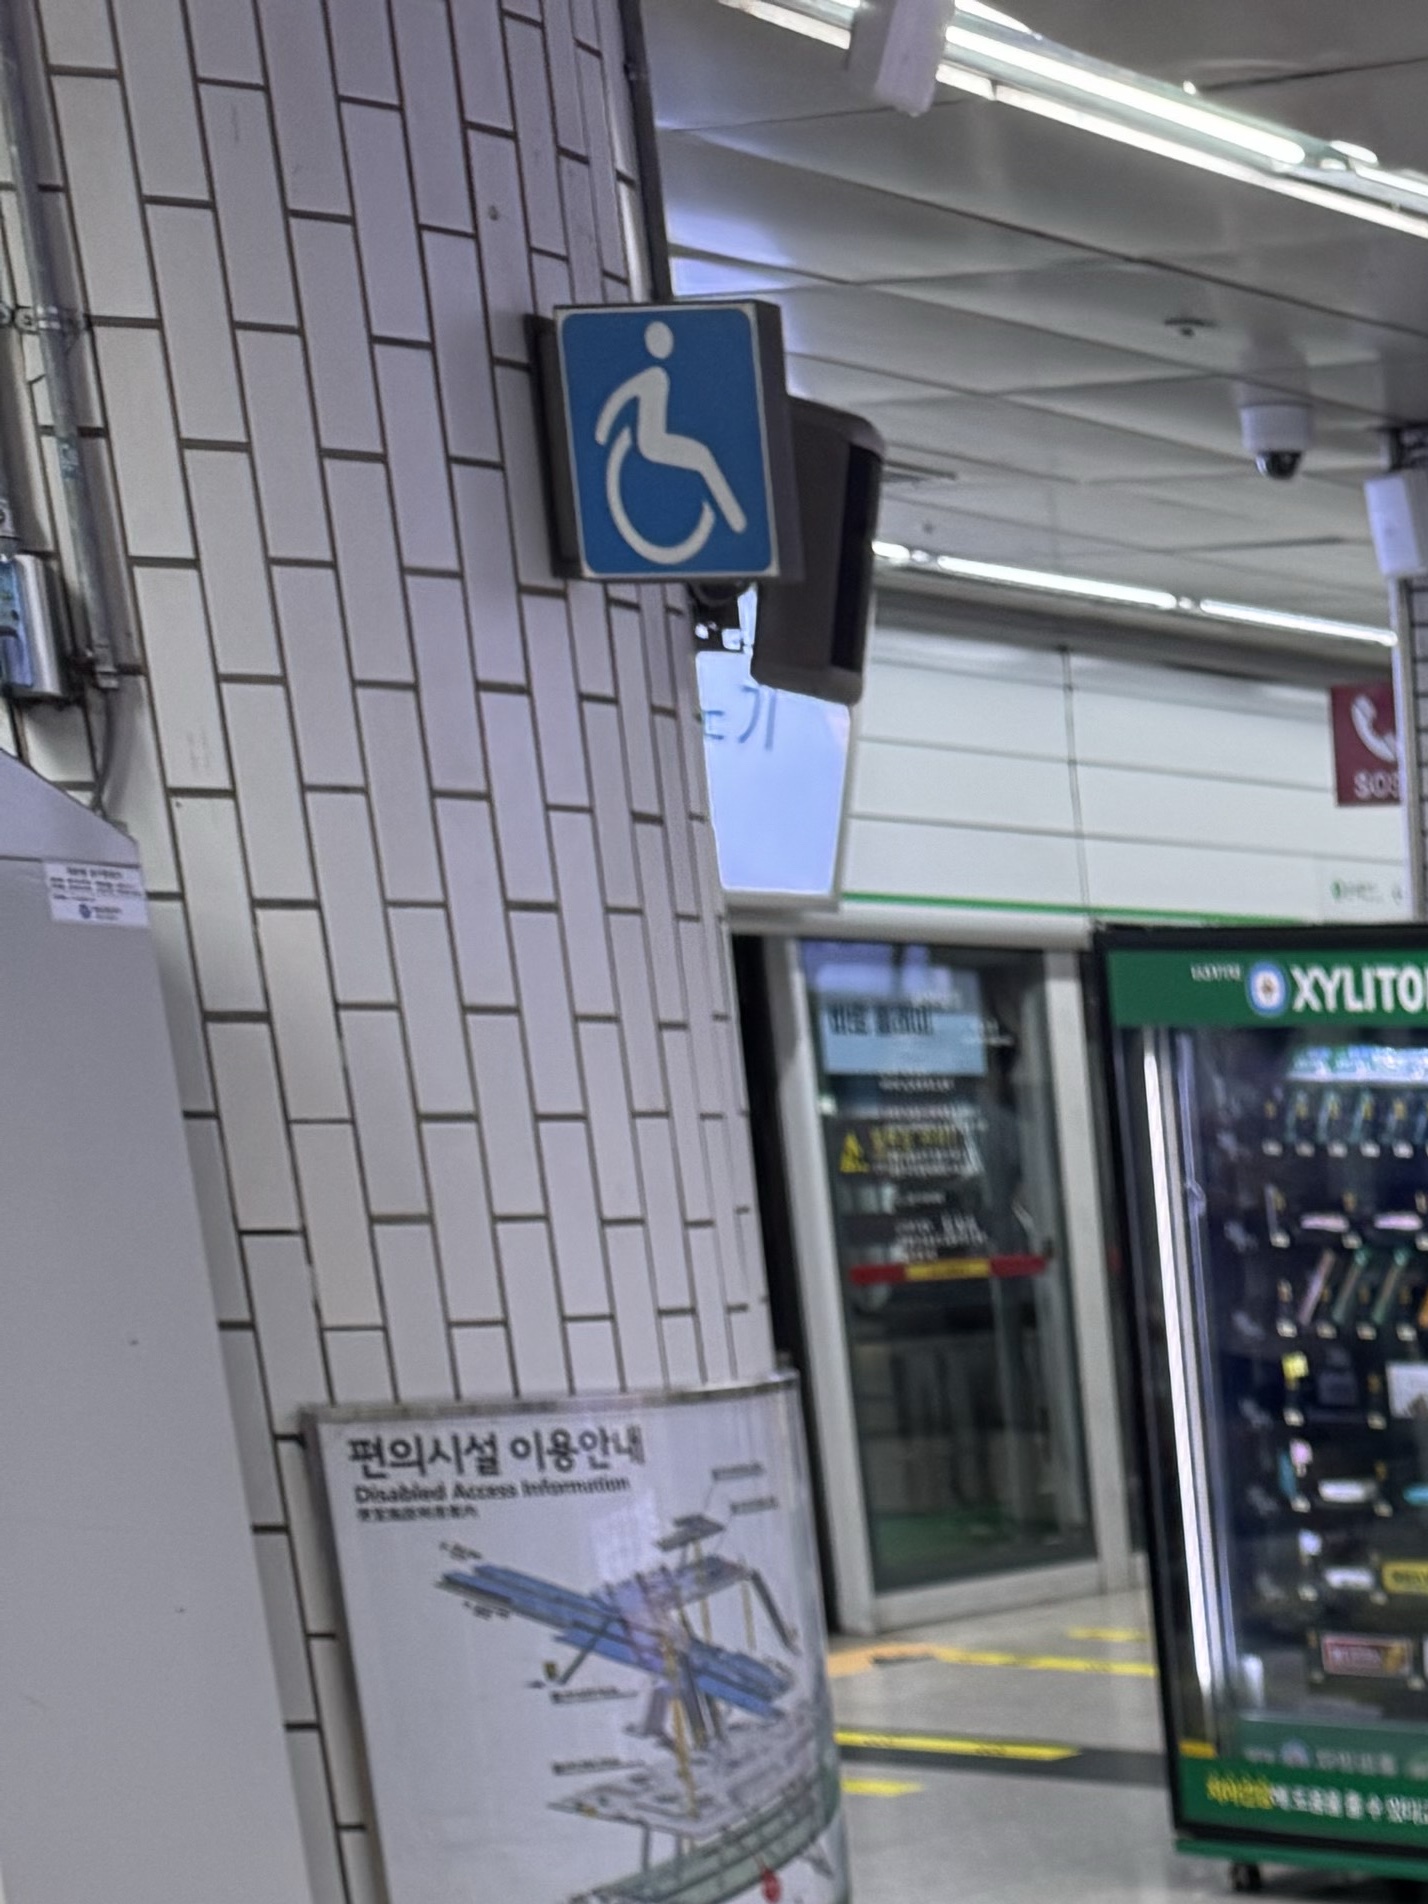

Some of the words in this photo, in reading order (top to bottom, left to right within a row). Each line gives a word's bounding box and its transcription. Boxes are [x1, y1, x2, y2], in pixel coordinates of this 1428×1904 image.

[348, 1433, 501, 1480] 편의시설
[509, 1425, 647, 1474] 이용안내
[354, 1481, 446, 1504] Disabled
[453, 1479, 518, 1500] Access
[521, 1475, 631, 1497] Information
